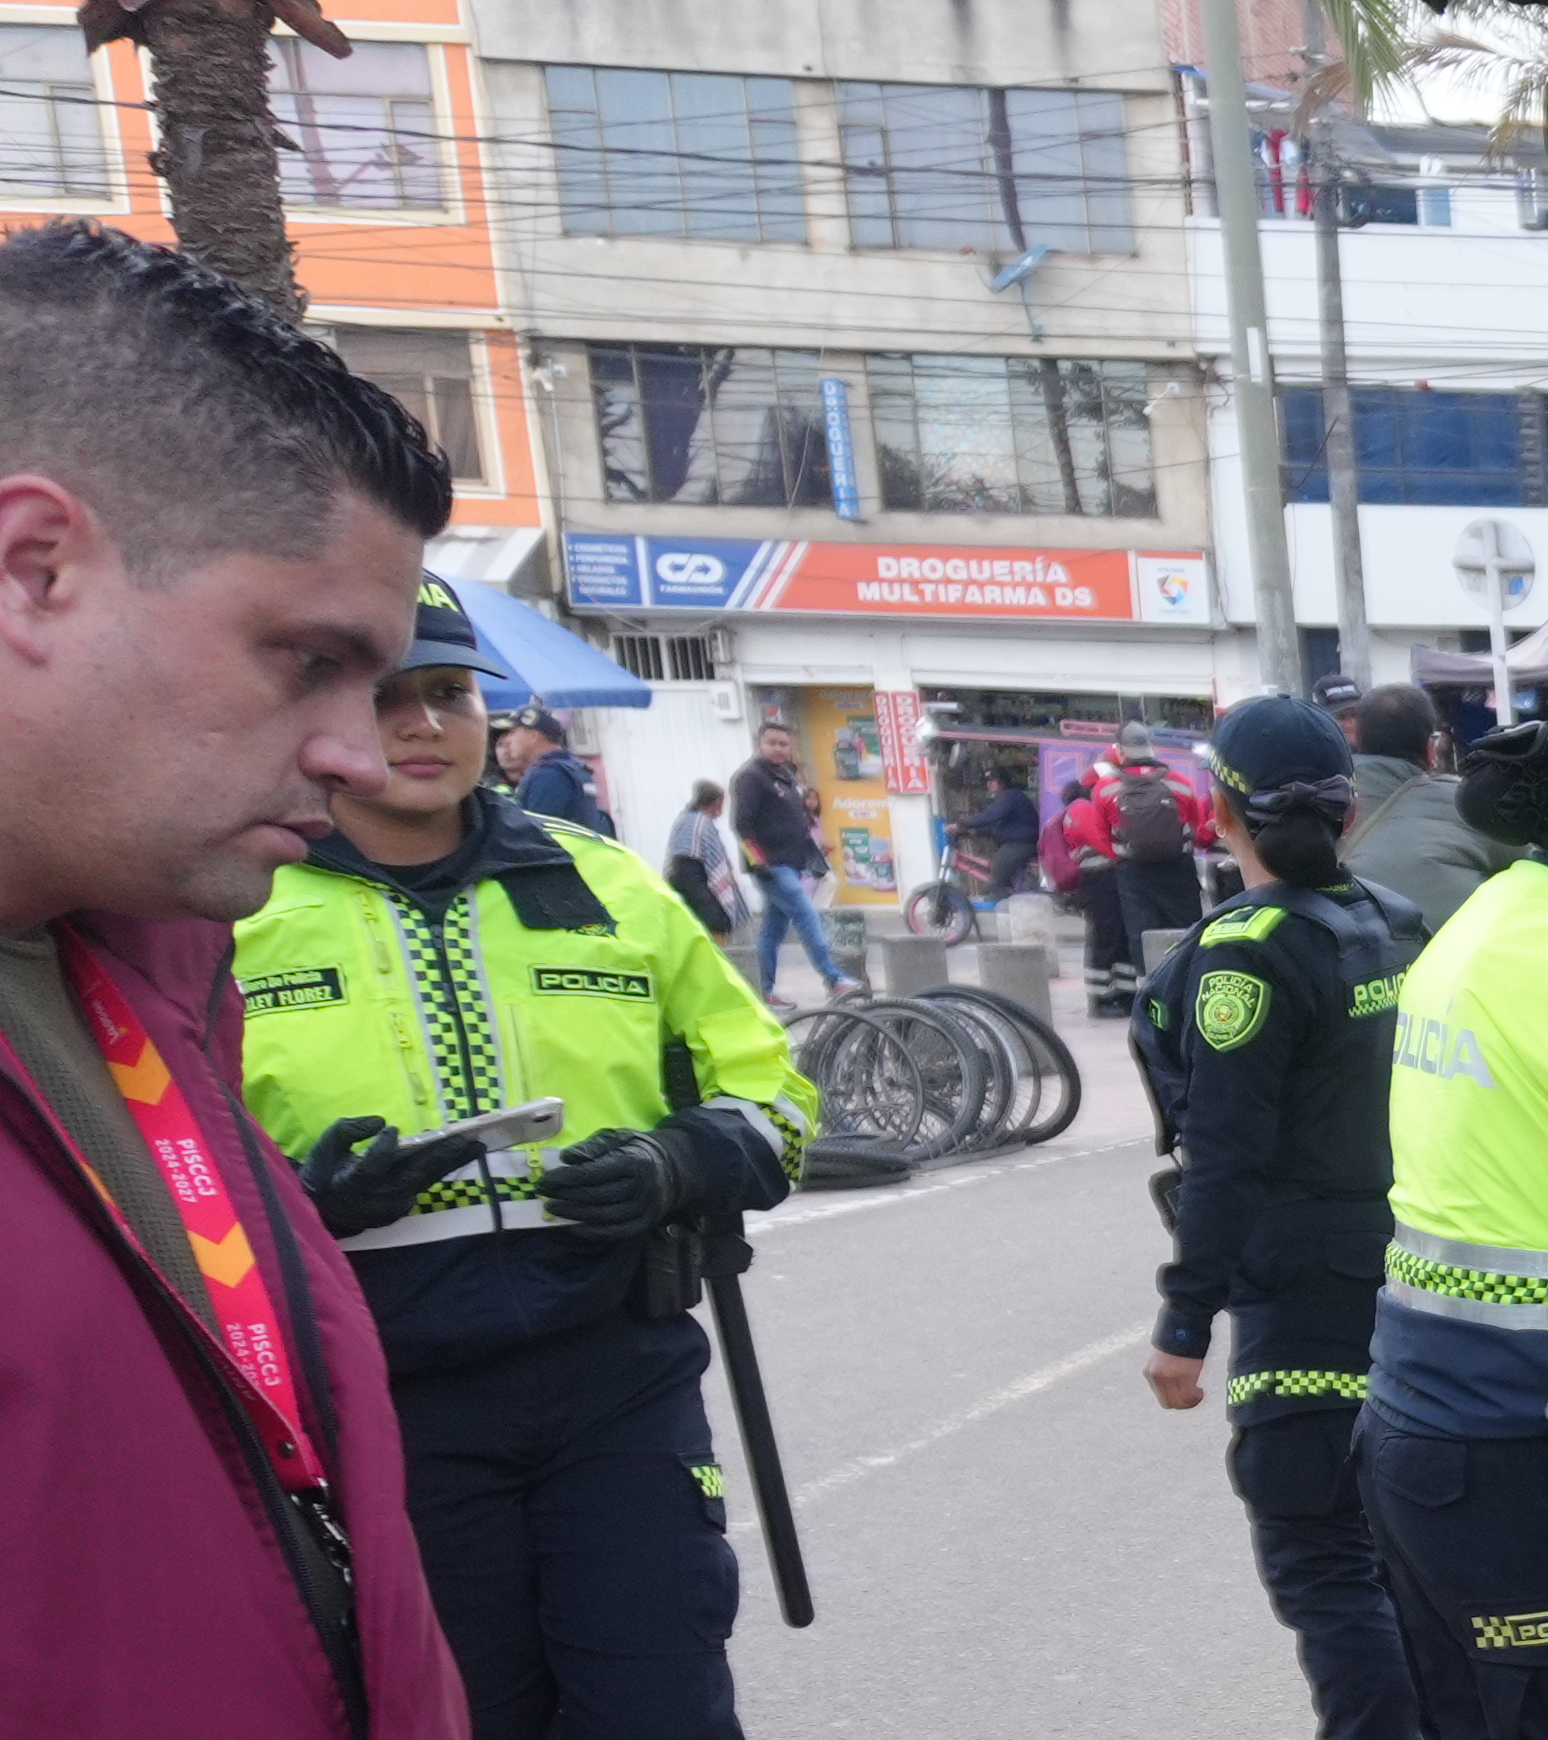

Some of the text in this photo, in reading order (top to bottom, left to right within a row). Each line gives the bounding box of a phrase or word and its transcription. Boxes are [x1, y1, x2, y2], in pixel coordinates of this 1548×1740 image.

[877, 555, 1068, 583] DROGUERÍA
[857, 582, 1093, 607] MULTIFARMA DS
[539, 973, 645, 995] POLICÍA
[155, 1138, 198, 1203] 2024-2027
[177, 1138, 218, 1197] PISCCJ
[247, 1322, 283, 1387] PISCCJ
